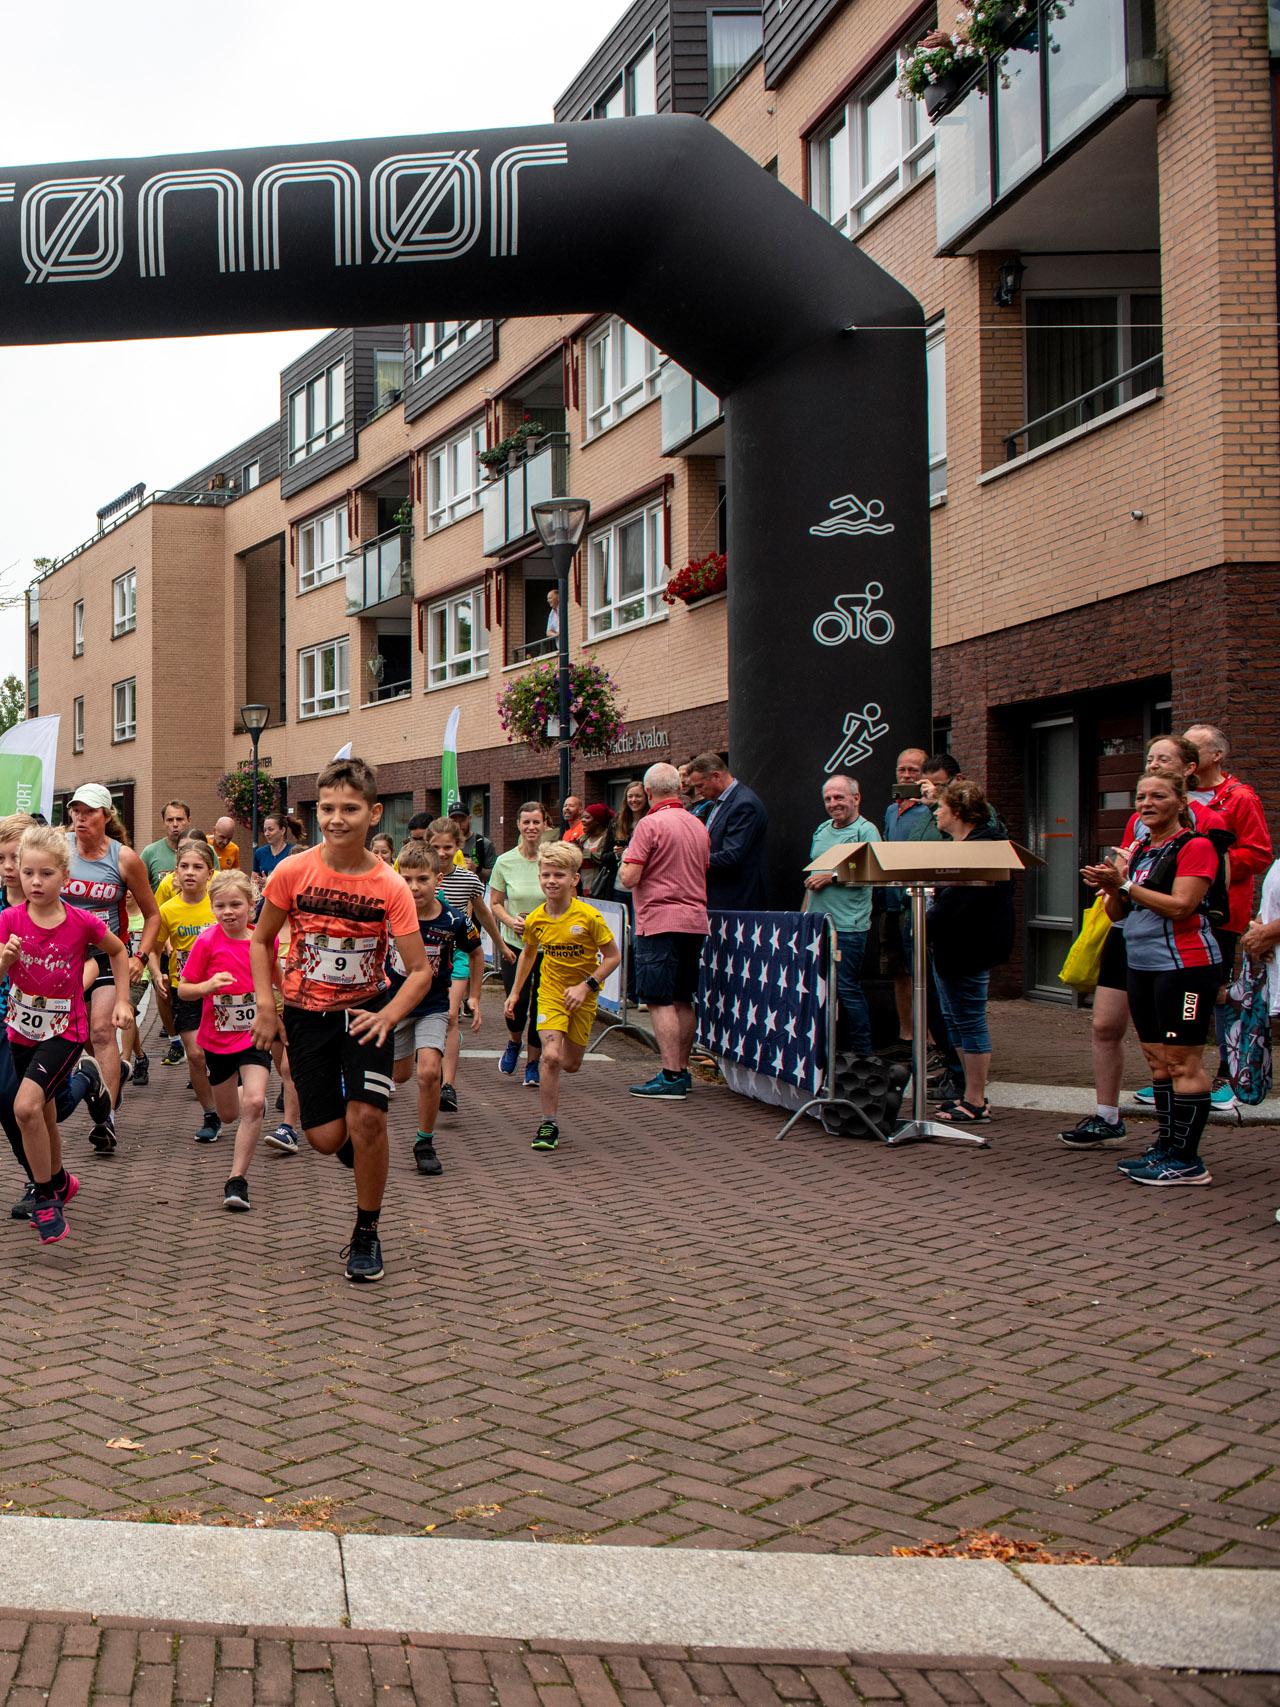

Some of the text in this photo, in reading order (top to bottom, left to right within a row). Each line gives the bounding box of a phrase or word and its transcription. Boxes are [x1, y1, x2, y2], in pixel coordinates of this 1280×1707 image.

[635, 726, 670, 752] Avalon
[335, 956, 347, 972] 9
[21, 1011, 43, 1029] 20
[235, 1008, 256, 1022] 30
